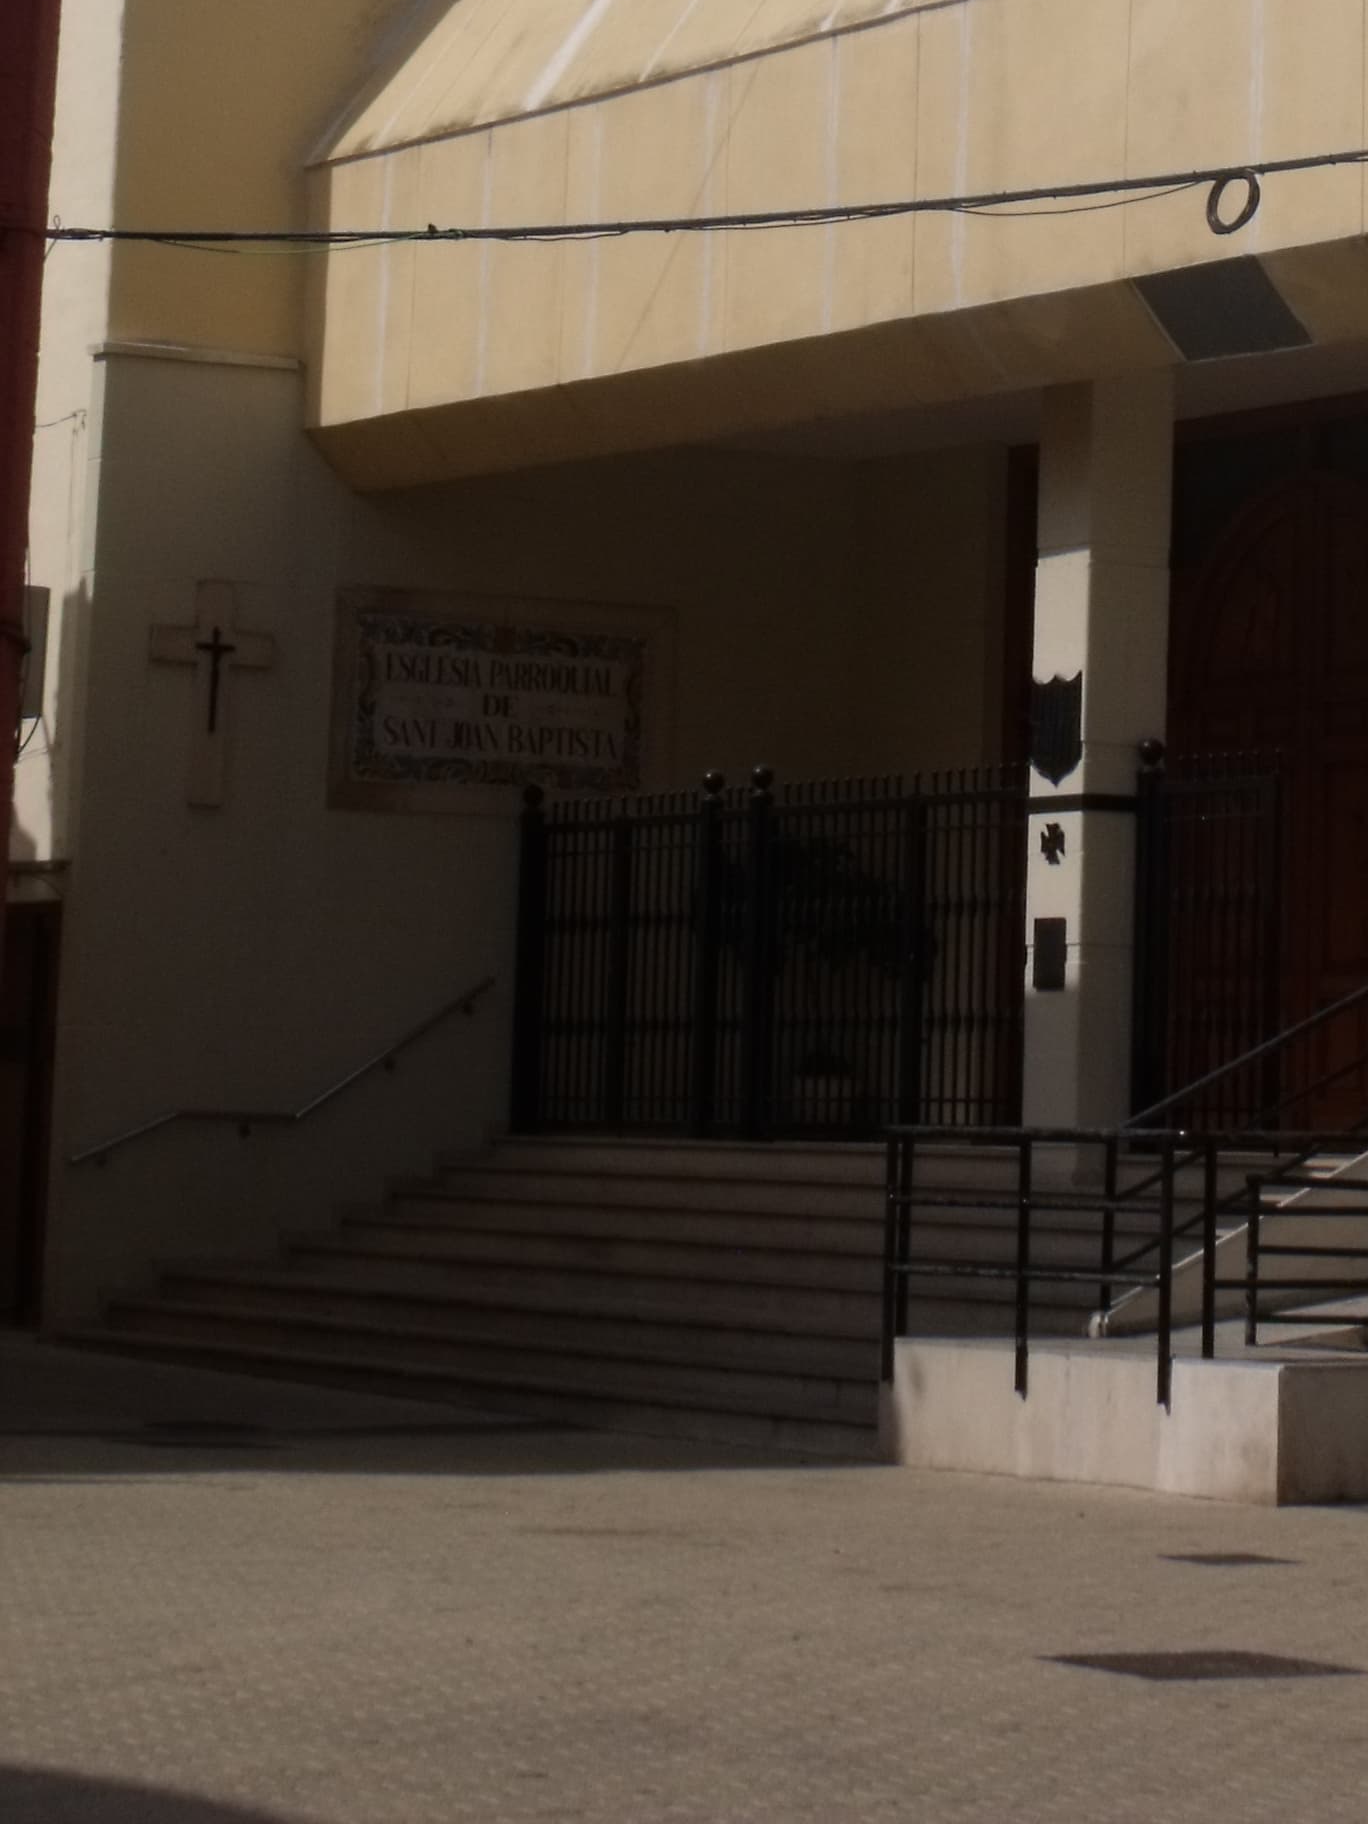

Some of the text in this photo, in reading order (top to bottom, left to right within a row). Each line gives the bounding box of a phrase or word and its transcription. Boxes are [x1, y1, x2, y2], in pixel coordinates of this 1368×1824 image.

[489, 659, 618, 697] PARROQUIAL
[482, 692, 514, 718] DE
[383, 714, 621, 761] SANT JOAN BAPTISTA
